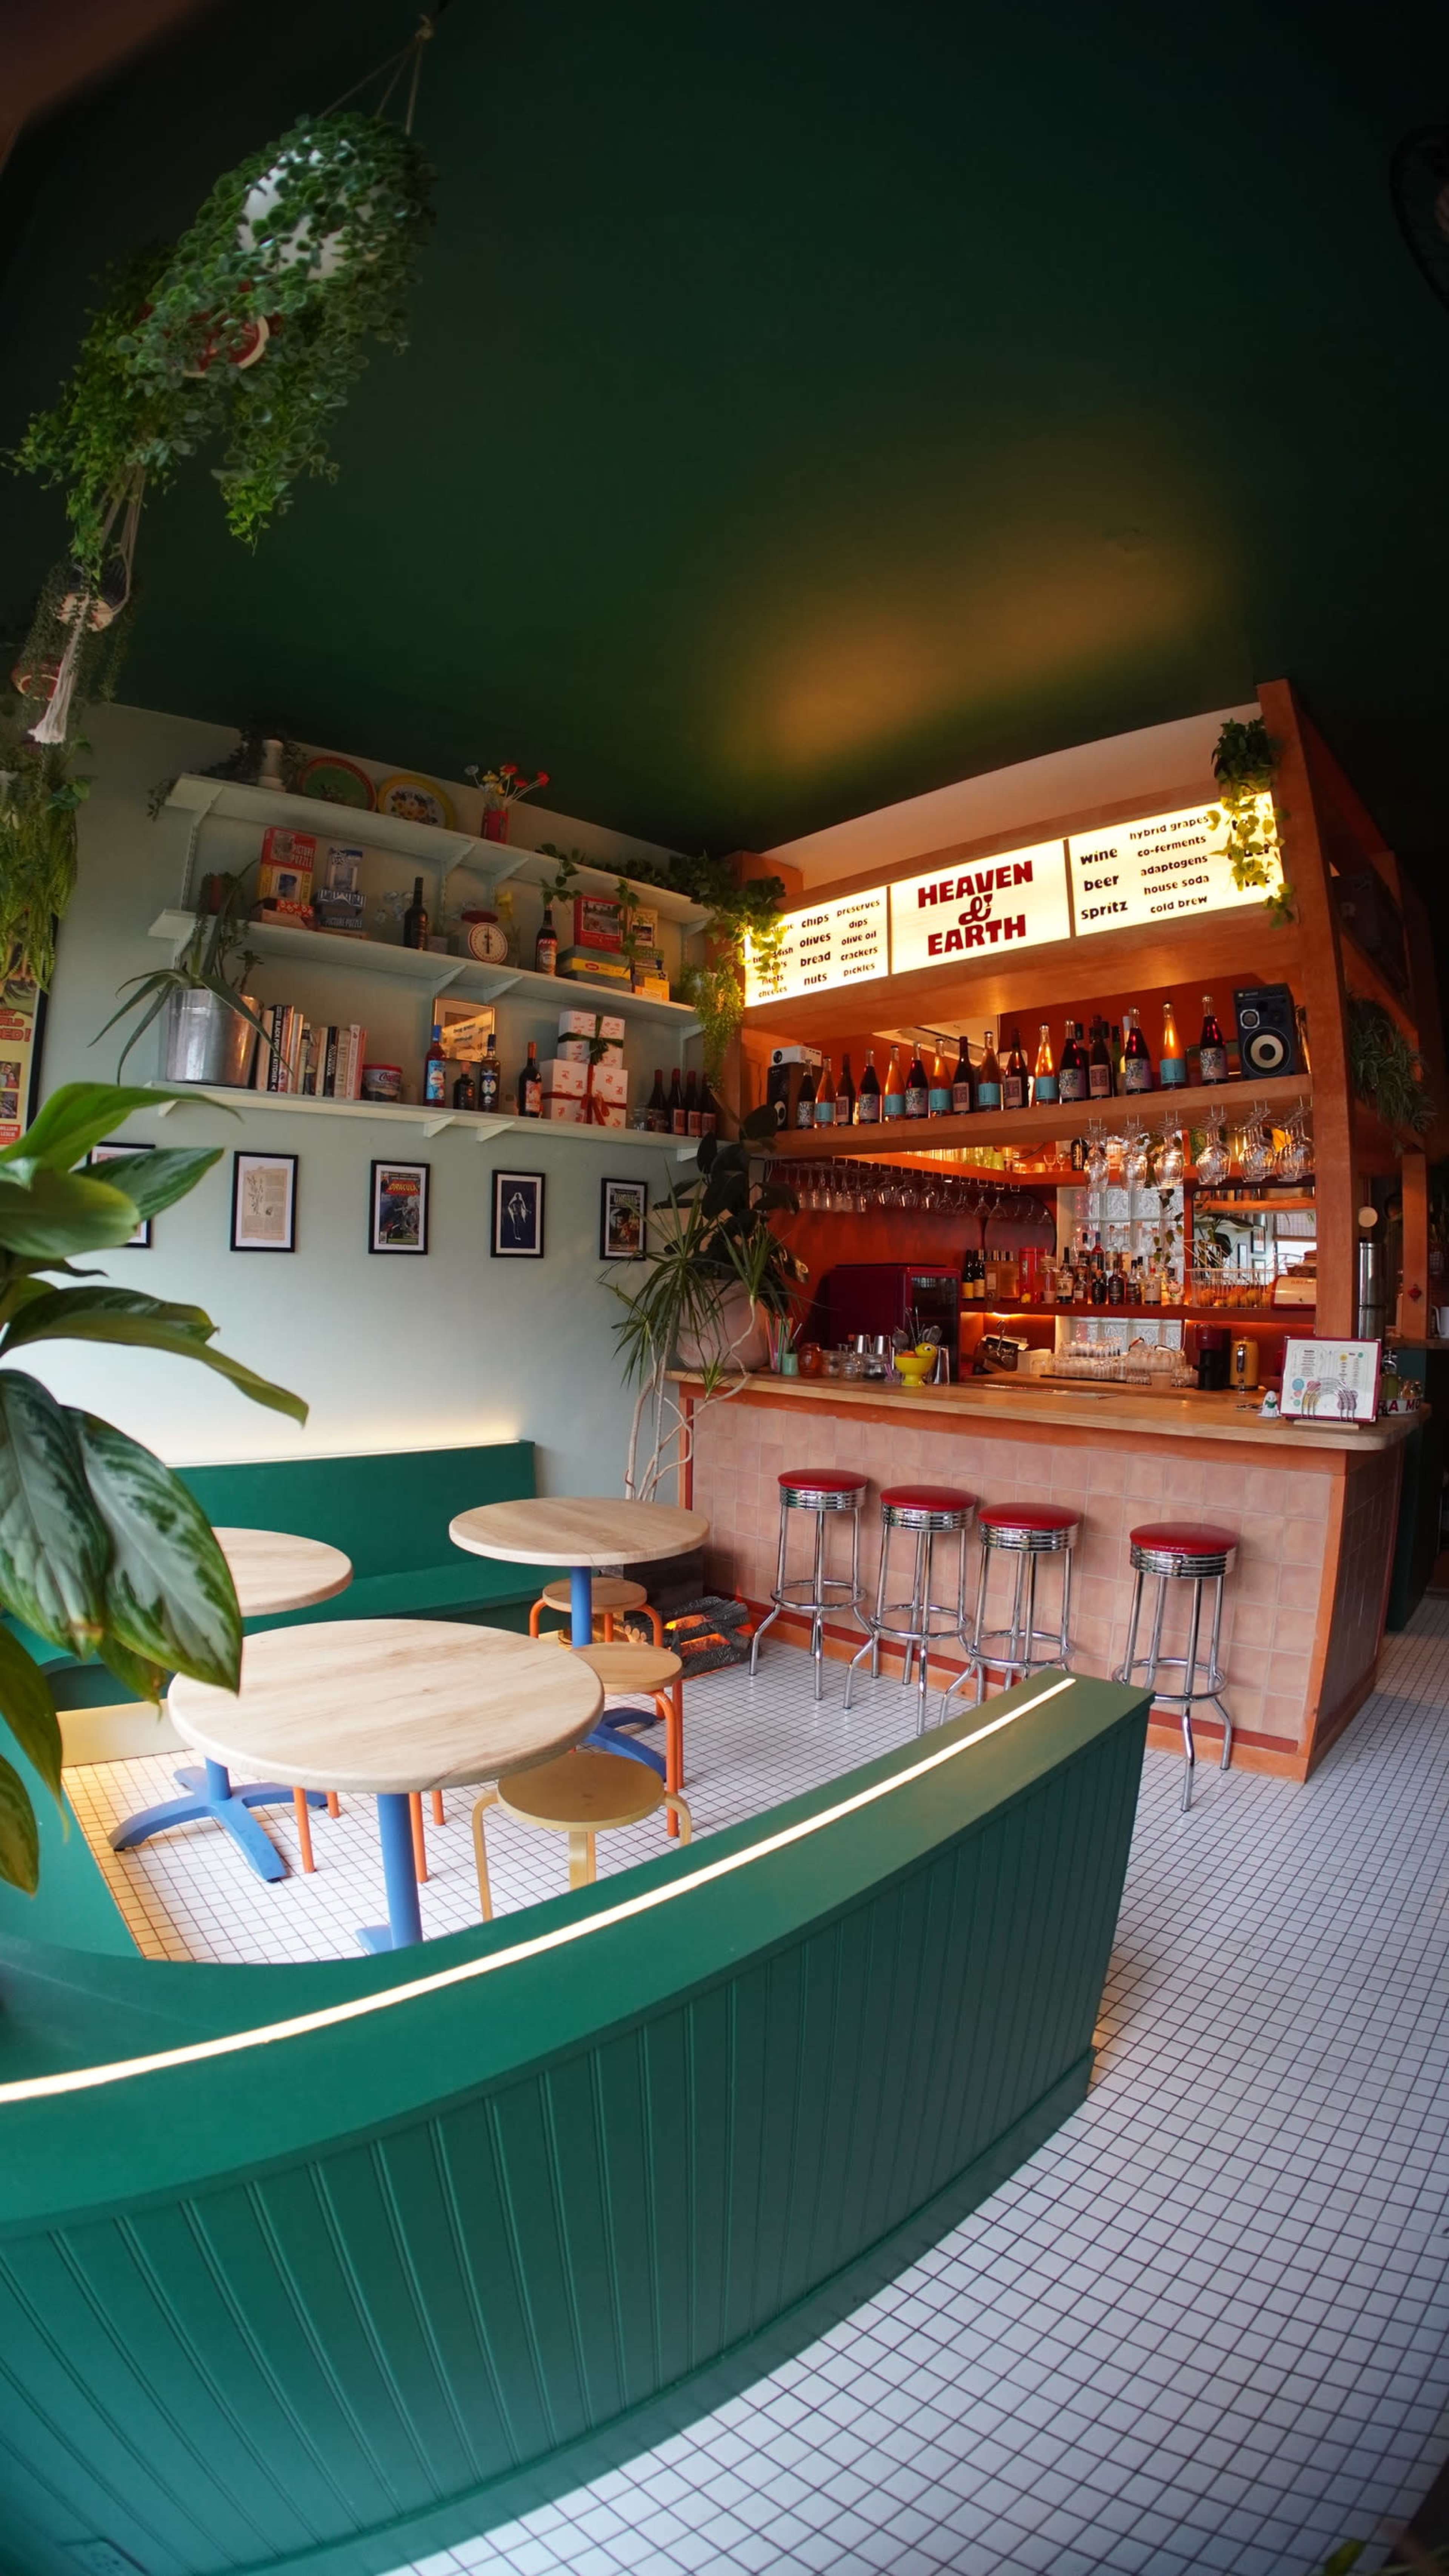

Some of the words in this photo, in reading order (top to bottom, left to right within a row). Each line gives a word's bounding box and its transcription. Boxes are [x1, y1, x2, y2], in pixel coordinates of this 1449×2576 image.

[1129, 825, 1167, 841] hybrid
[1170, 815, 1209, 831] grapes
[1137, 836, 1206, 858] co-ferments
[1080, 848, 1118, 865] wine
[1141, 855, 1208, 876] adaptogens
[918, 860, 1033, 908] HEAVEN
[1084, 875, 1120, 892] beer
[1144, 881, 1178, 895] house
[1182, 875, 1210, 887] soda
[837, 899, 880, 917] preserves
[1081, 900, 1128, 920] spritz
[1150, 902, 1174, 913] cold
[1178, 896, 1208, 908] brew
[801, 914, 829, 928] chips
[849, 918, 868, 928] dips
[800, 933, 831, 948] olives
[841, 935, 863, 945] olive
[865, 930, 877, 940] oil
[928, 914, 1026, 956] EARTH
[800, 951, 831, 967] bread
[841, 946, 878, 961] crackers
[843, 963, 875, 977] pickles
[804, 973, 827, 986] nuts
[388, 1183, 418, 1192] DRACULA
